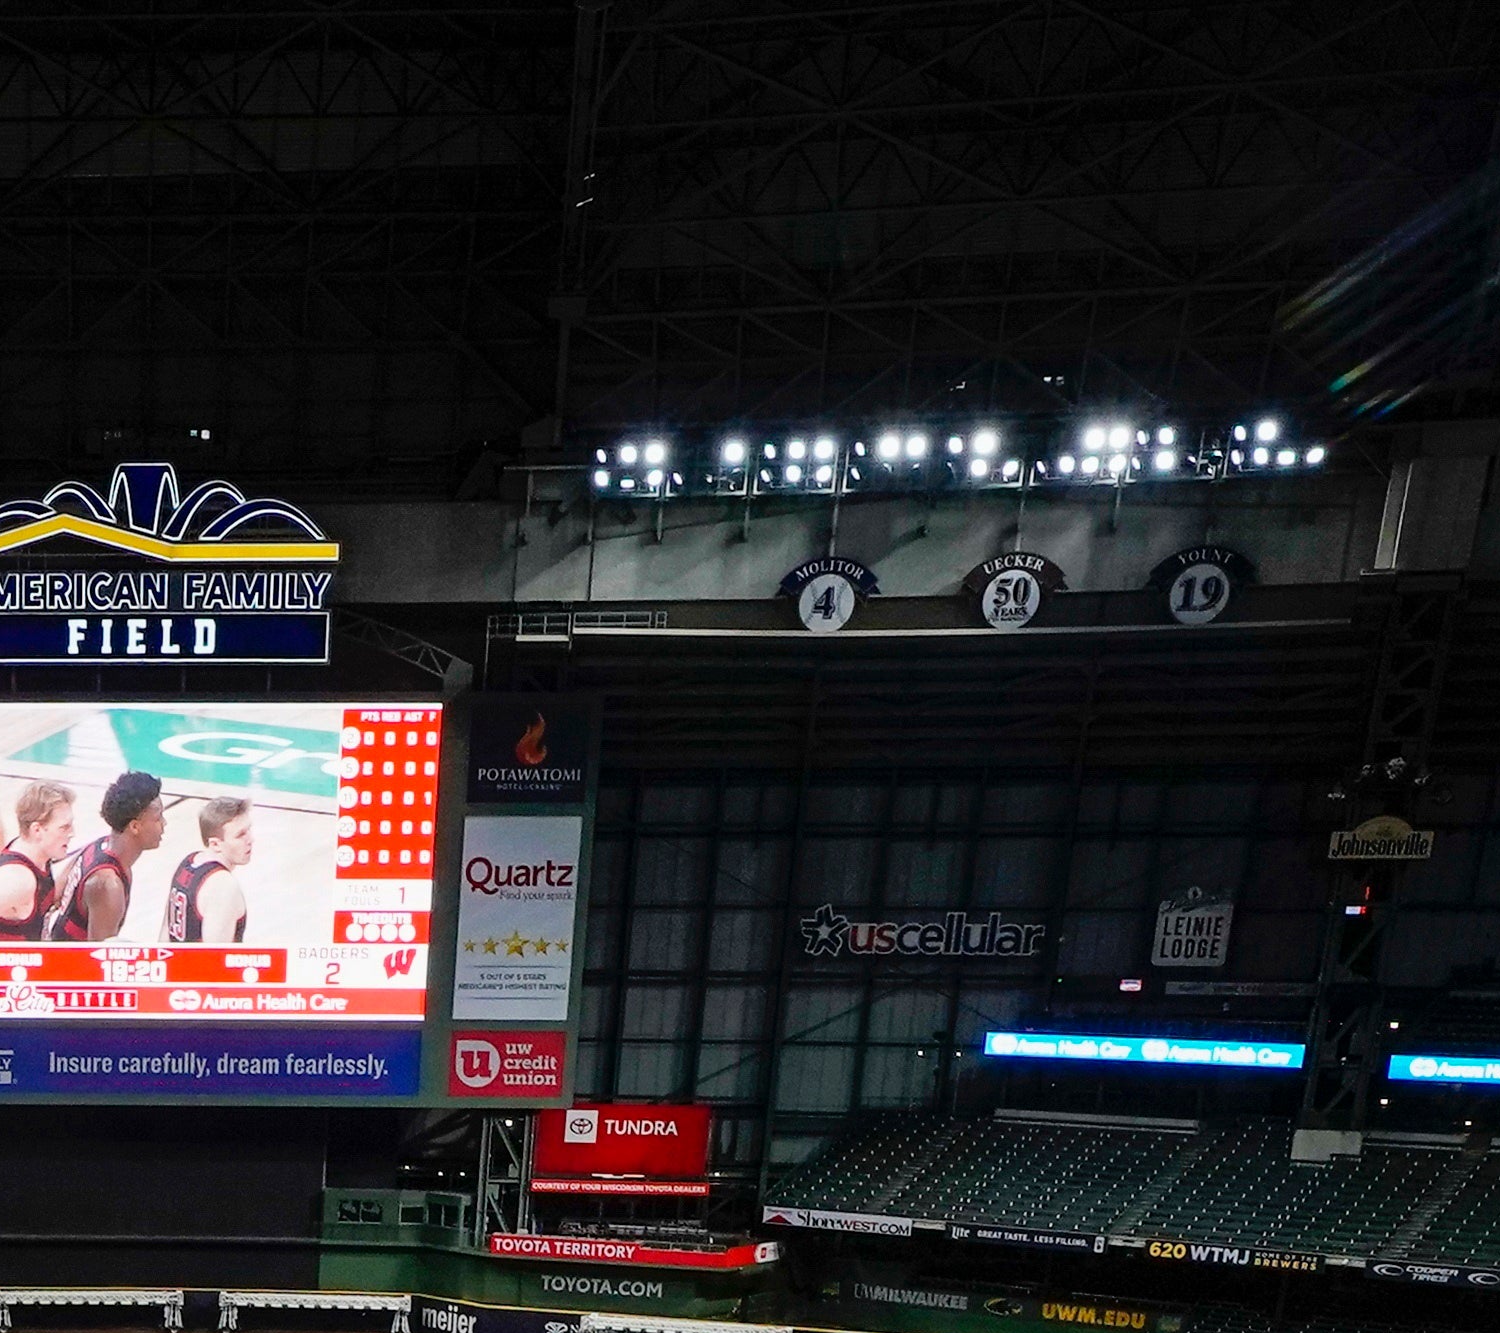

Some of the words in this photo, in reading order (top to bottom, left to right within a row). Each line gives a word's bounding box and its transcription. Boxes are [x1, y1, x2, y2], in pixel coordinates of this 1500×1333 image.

[984, 556, 1044, 575] UECKER
[1178, 549, 1234, 566] YOUNT
[795, 560, 865, 582] MOLITOR
[183, 572, 331, 610] FAMILY
[994, 579, 1028, 607] 50
[1176, 576, 1223, 613] 19
[812, 586, 835, 620] 4
[67, 618, 216, 655] FIELD
[477, 767, 581, 782] POTAWATOMI
[1330, 834, 1430, 858] Johnsonville
[465, 857, 573, 895] Quartz
[1162, 915, 1223, 938] LEINIE
[298, 947, 369, 960] BADGERS
[1159, 938, 1219, 959] LODGE
[325, 962, 340, 985] 2
[10, 985, 51, 1013] City
[56, 991, 131, 1008] BATTLE
[202, 993, 253, 1011] Aurora
[257, 992, 306, 1011] Health
[309, 994, 348, 1011] Care
[505, 1042, 532, 1055] uw
[49, 1051, 112, 1074] Insure
[118, 1051, 211, 1078] carefully,
[217, 1052, 279, 1075] dream
[286, 1053, 389, 1079] fearlessly.
[503, 1055, 557, 1070] credit
[503, 1071, 557, 1086] union
[604, 1119, 678, 1137] TUNDRA
[951, 1225, 970, 1240] Lite
[977, 1229, 1002, 1240] GREAT
[1004, 1231, 1030, 1242] TASTE.
[1034, 1234, 1054, 1244] LESS
[1055, 1236, 1089, 1248] FILLING.
[494, 1237, 550, 1255] TOYOTA
[554, 1240, 636, 1259] TERRITORY
[1149, 1241, 1187, 1260] 620
[1189, 1245, 1251, 1266] WTMJ
[1254, 1258, 1318, 1272] BREWERS
[1405, 1265, 1458, 1278] COOPER
[541, 1274, 663, 1298] TOYOTA.COM
[1411, 1272, 1449, 1284] TIRES
[1041, 1301, 1146, 1331] UWM.EDU
